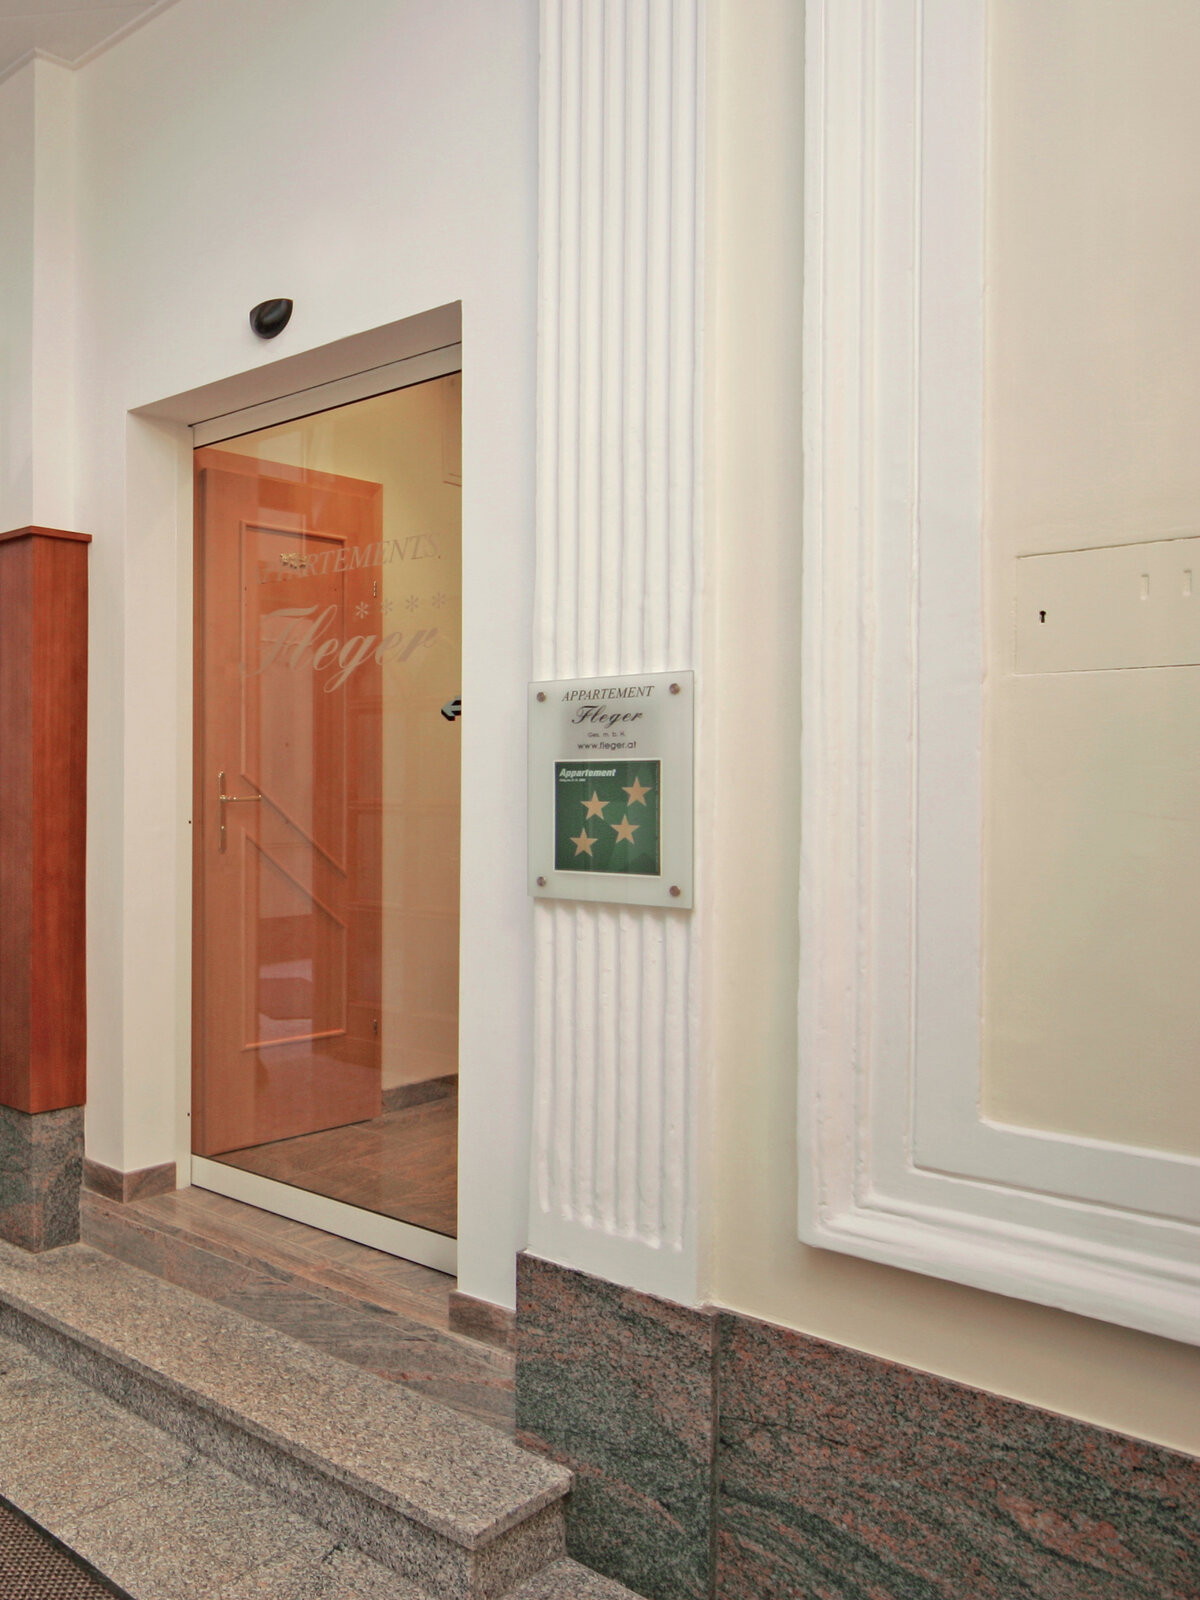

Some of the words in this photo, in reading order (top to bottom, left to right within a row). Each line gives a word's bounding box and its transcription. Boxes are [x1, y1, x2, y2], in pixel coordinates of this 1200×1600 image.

[238, 603, 440, 693] Fleger
[561, 685, 655, 702] APPARTEMENT
[571, 705, 643, 729] Fleger
[559, 768, 617, 778] Appartement
